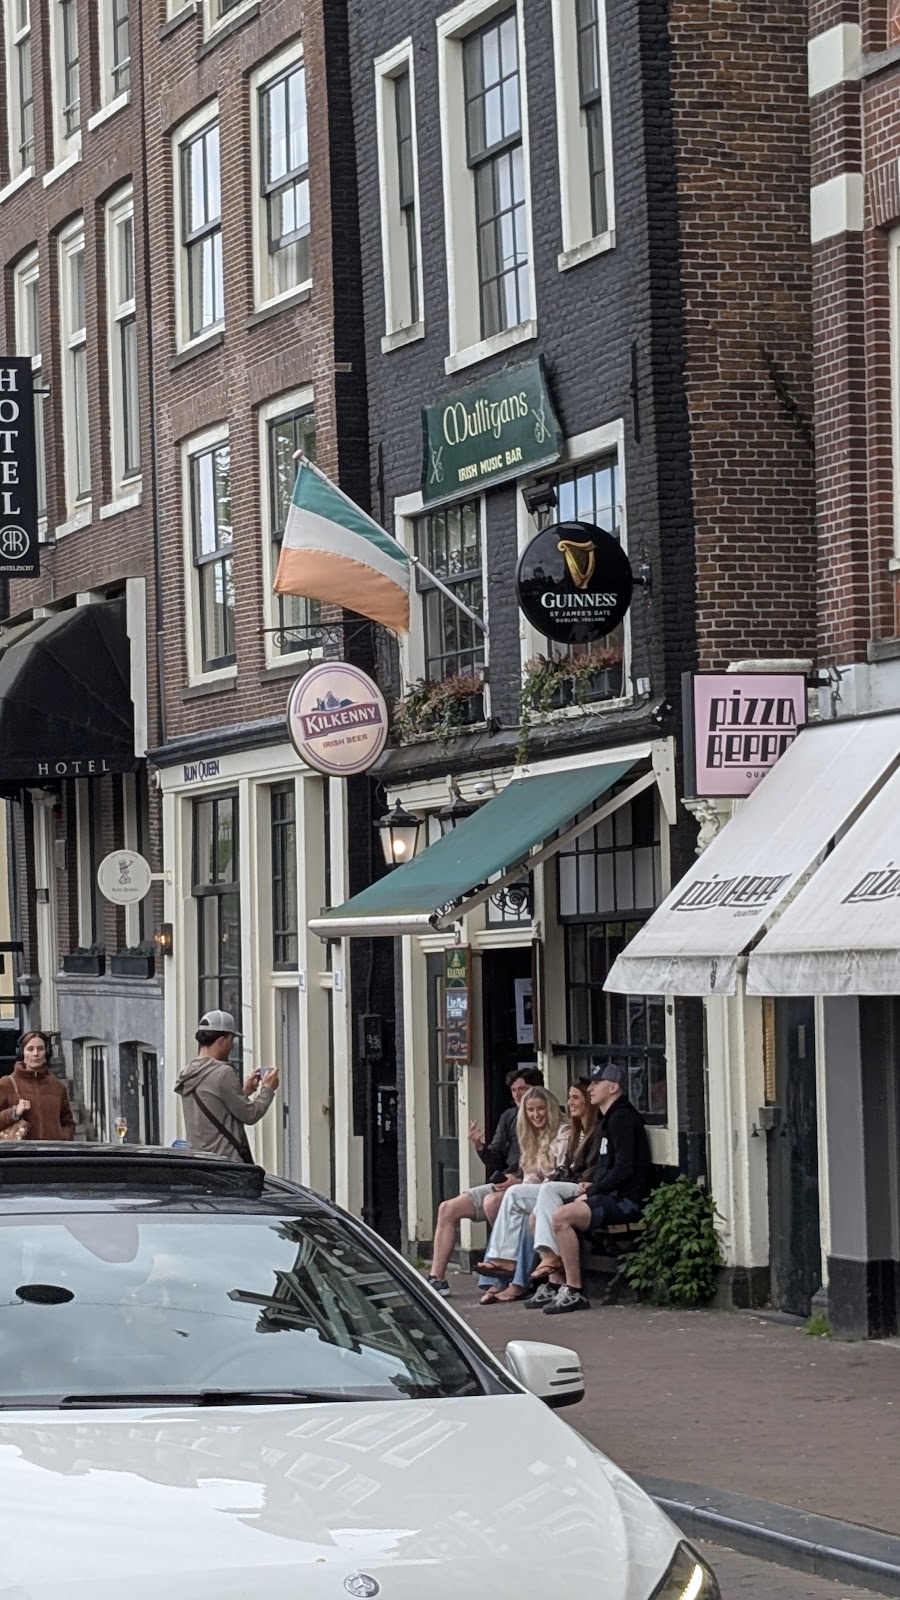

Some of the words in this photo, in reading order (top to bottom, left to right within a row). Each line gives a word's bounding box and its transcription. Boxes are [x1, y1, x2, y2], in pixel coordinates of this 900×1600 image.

[443, 391, 528, 446] Mulligans
[0, 368, 20, 515] HOTEL
[458, 463, 477, 482] IRISH
[480, 454, 503, 475] MUSIC
[505, 447, 523, 466] BAR
[541, 592, 618, 609] GUINNESS
[305, 706, 376, 735] KILKENNY
[323, 740, 345, 749] IRISH
[347, 733, 368, 744] BEER
[38, 759, 110, 776] HOTEL
[198, 760, 220, 782] QUEEN
